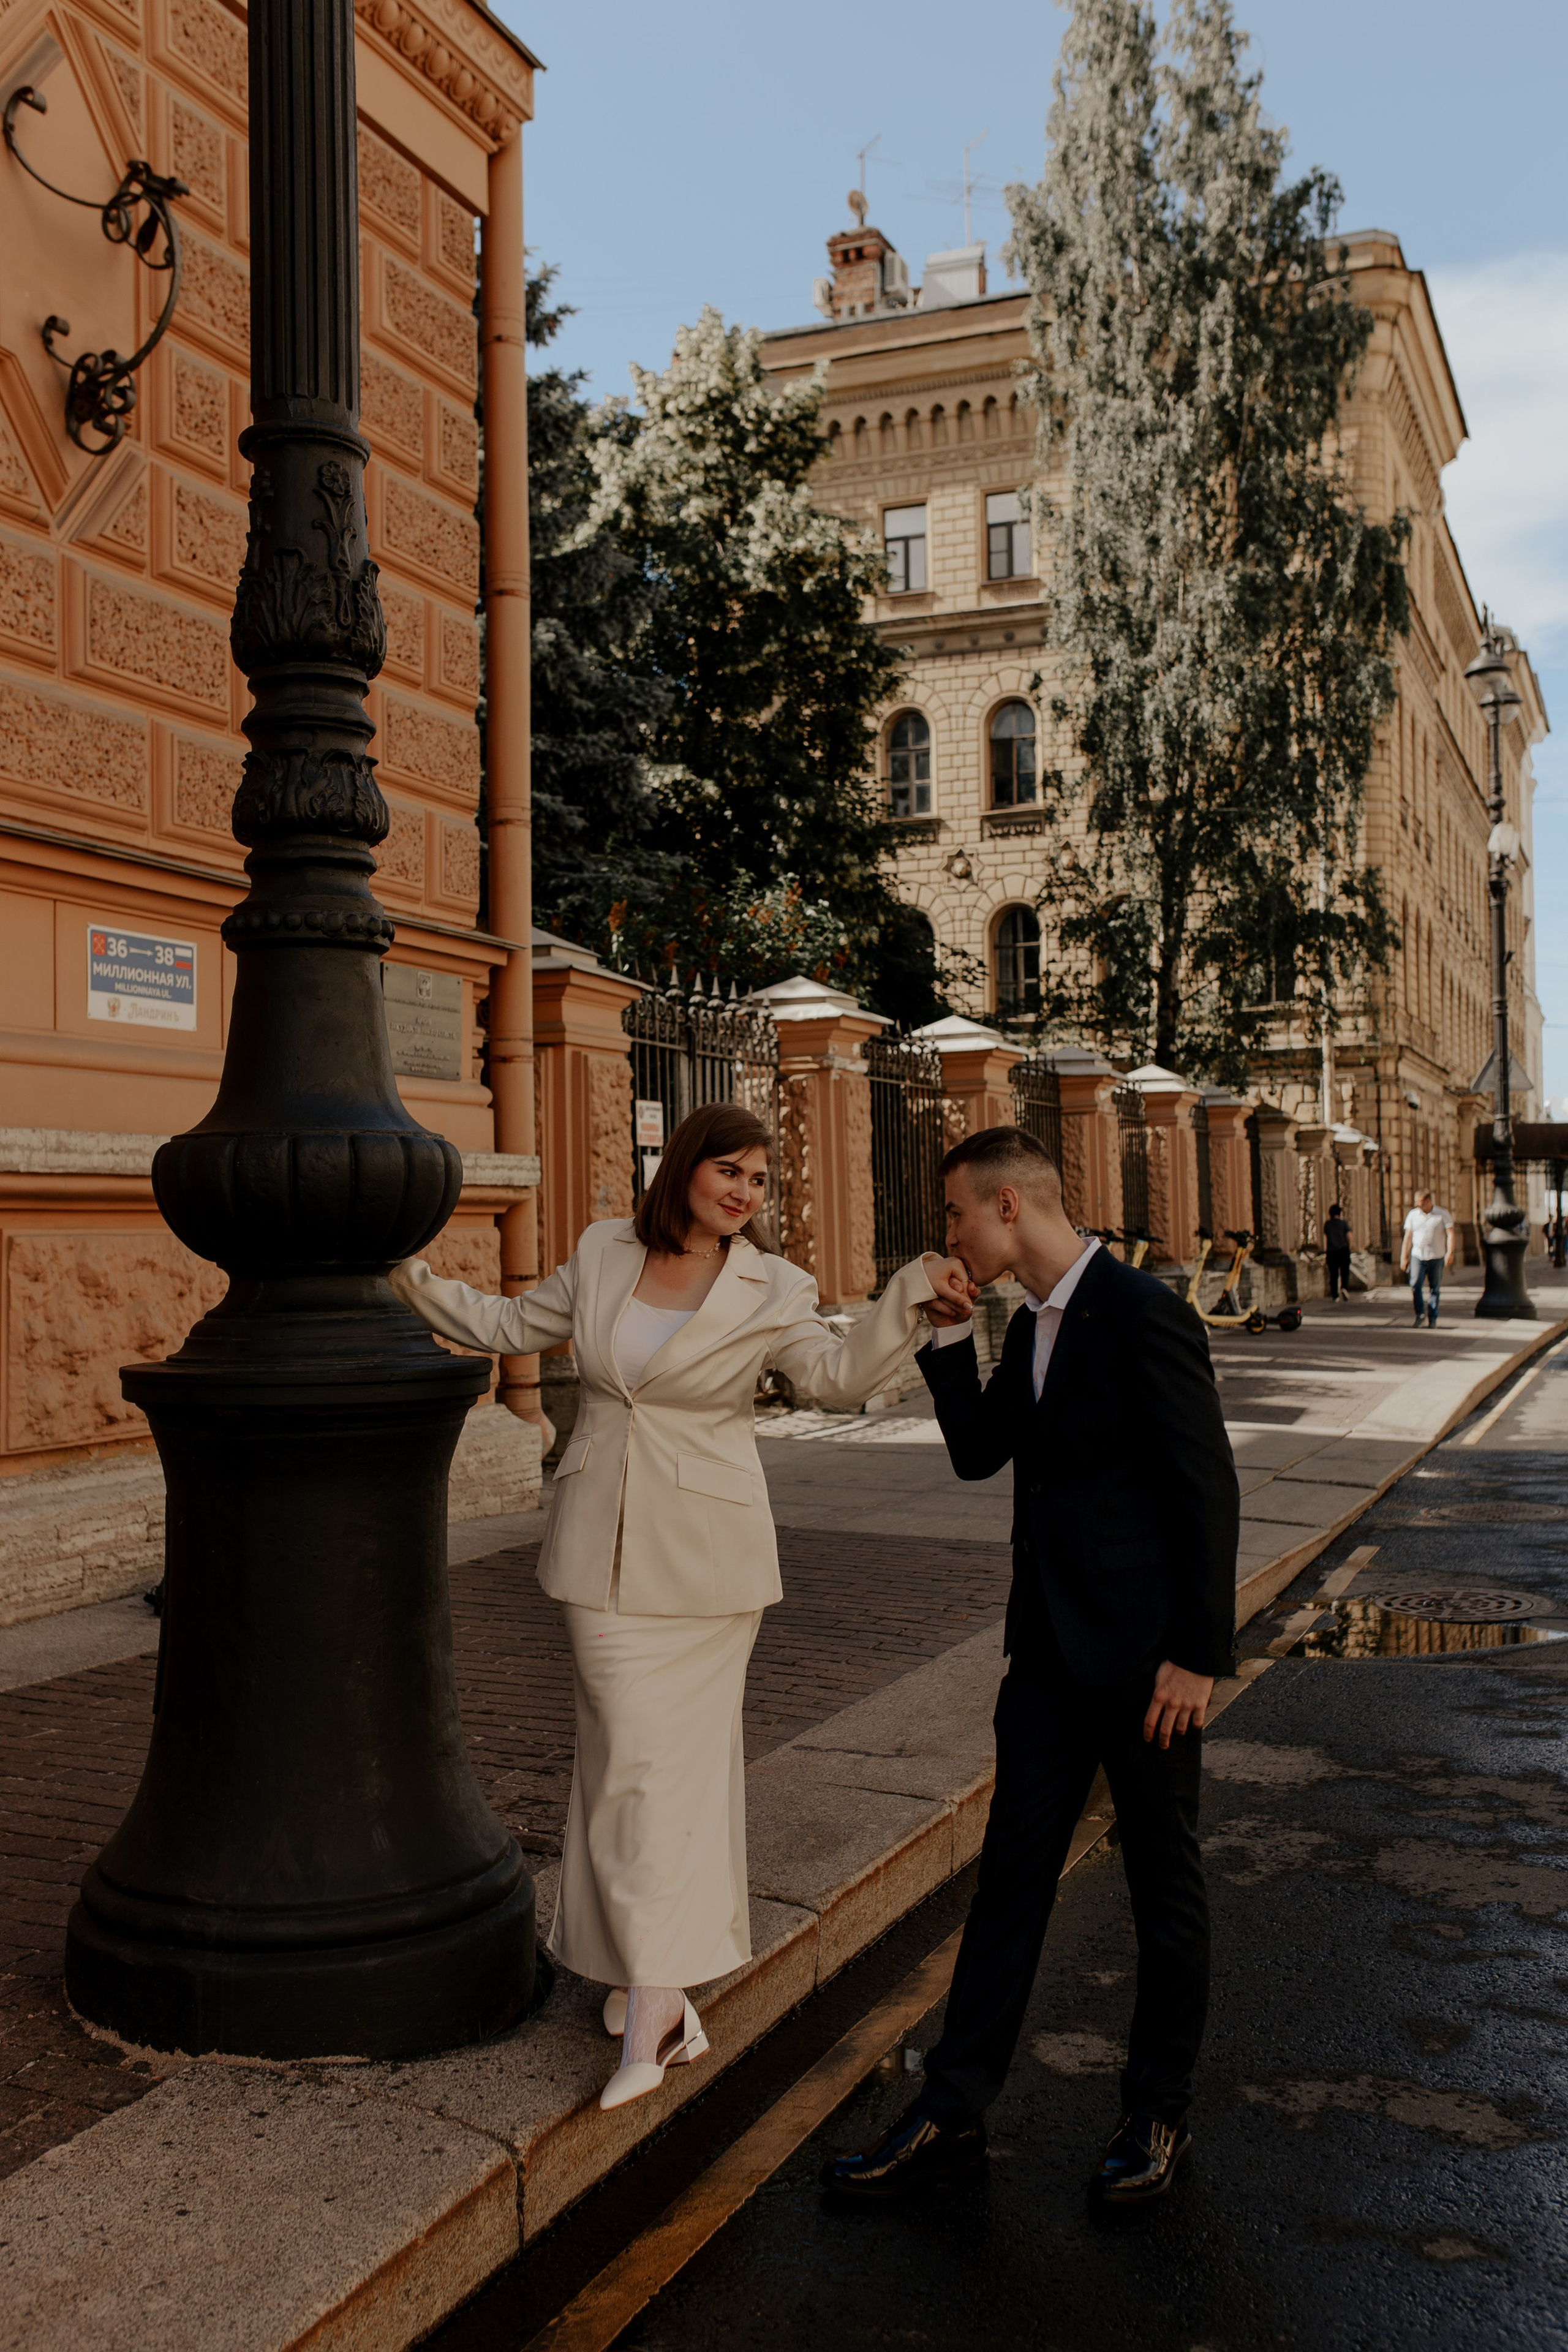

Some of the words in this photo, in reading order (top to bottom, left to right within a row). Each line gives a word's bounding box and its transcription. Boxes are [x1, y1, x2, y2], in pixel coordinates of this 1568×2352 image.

[107, 937, 127, 958] 36
[154, 946, 174, 965] 38
[92, 961, 174, 987] МИЛЛИОННАЯ
[175, 974, 192, 989] УЛ.
[115, 982, 160, 997] MILLIONNAYA
[162, 990, 172, 999] UL.
